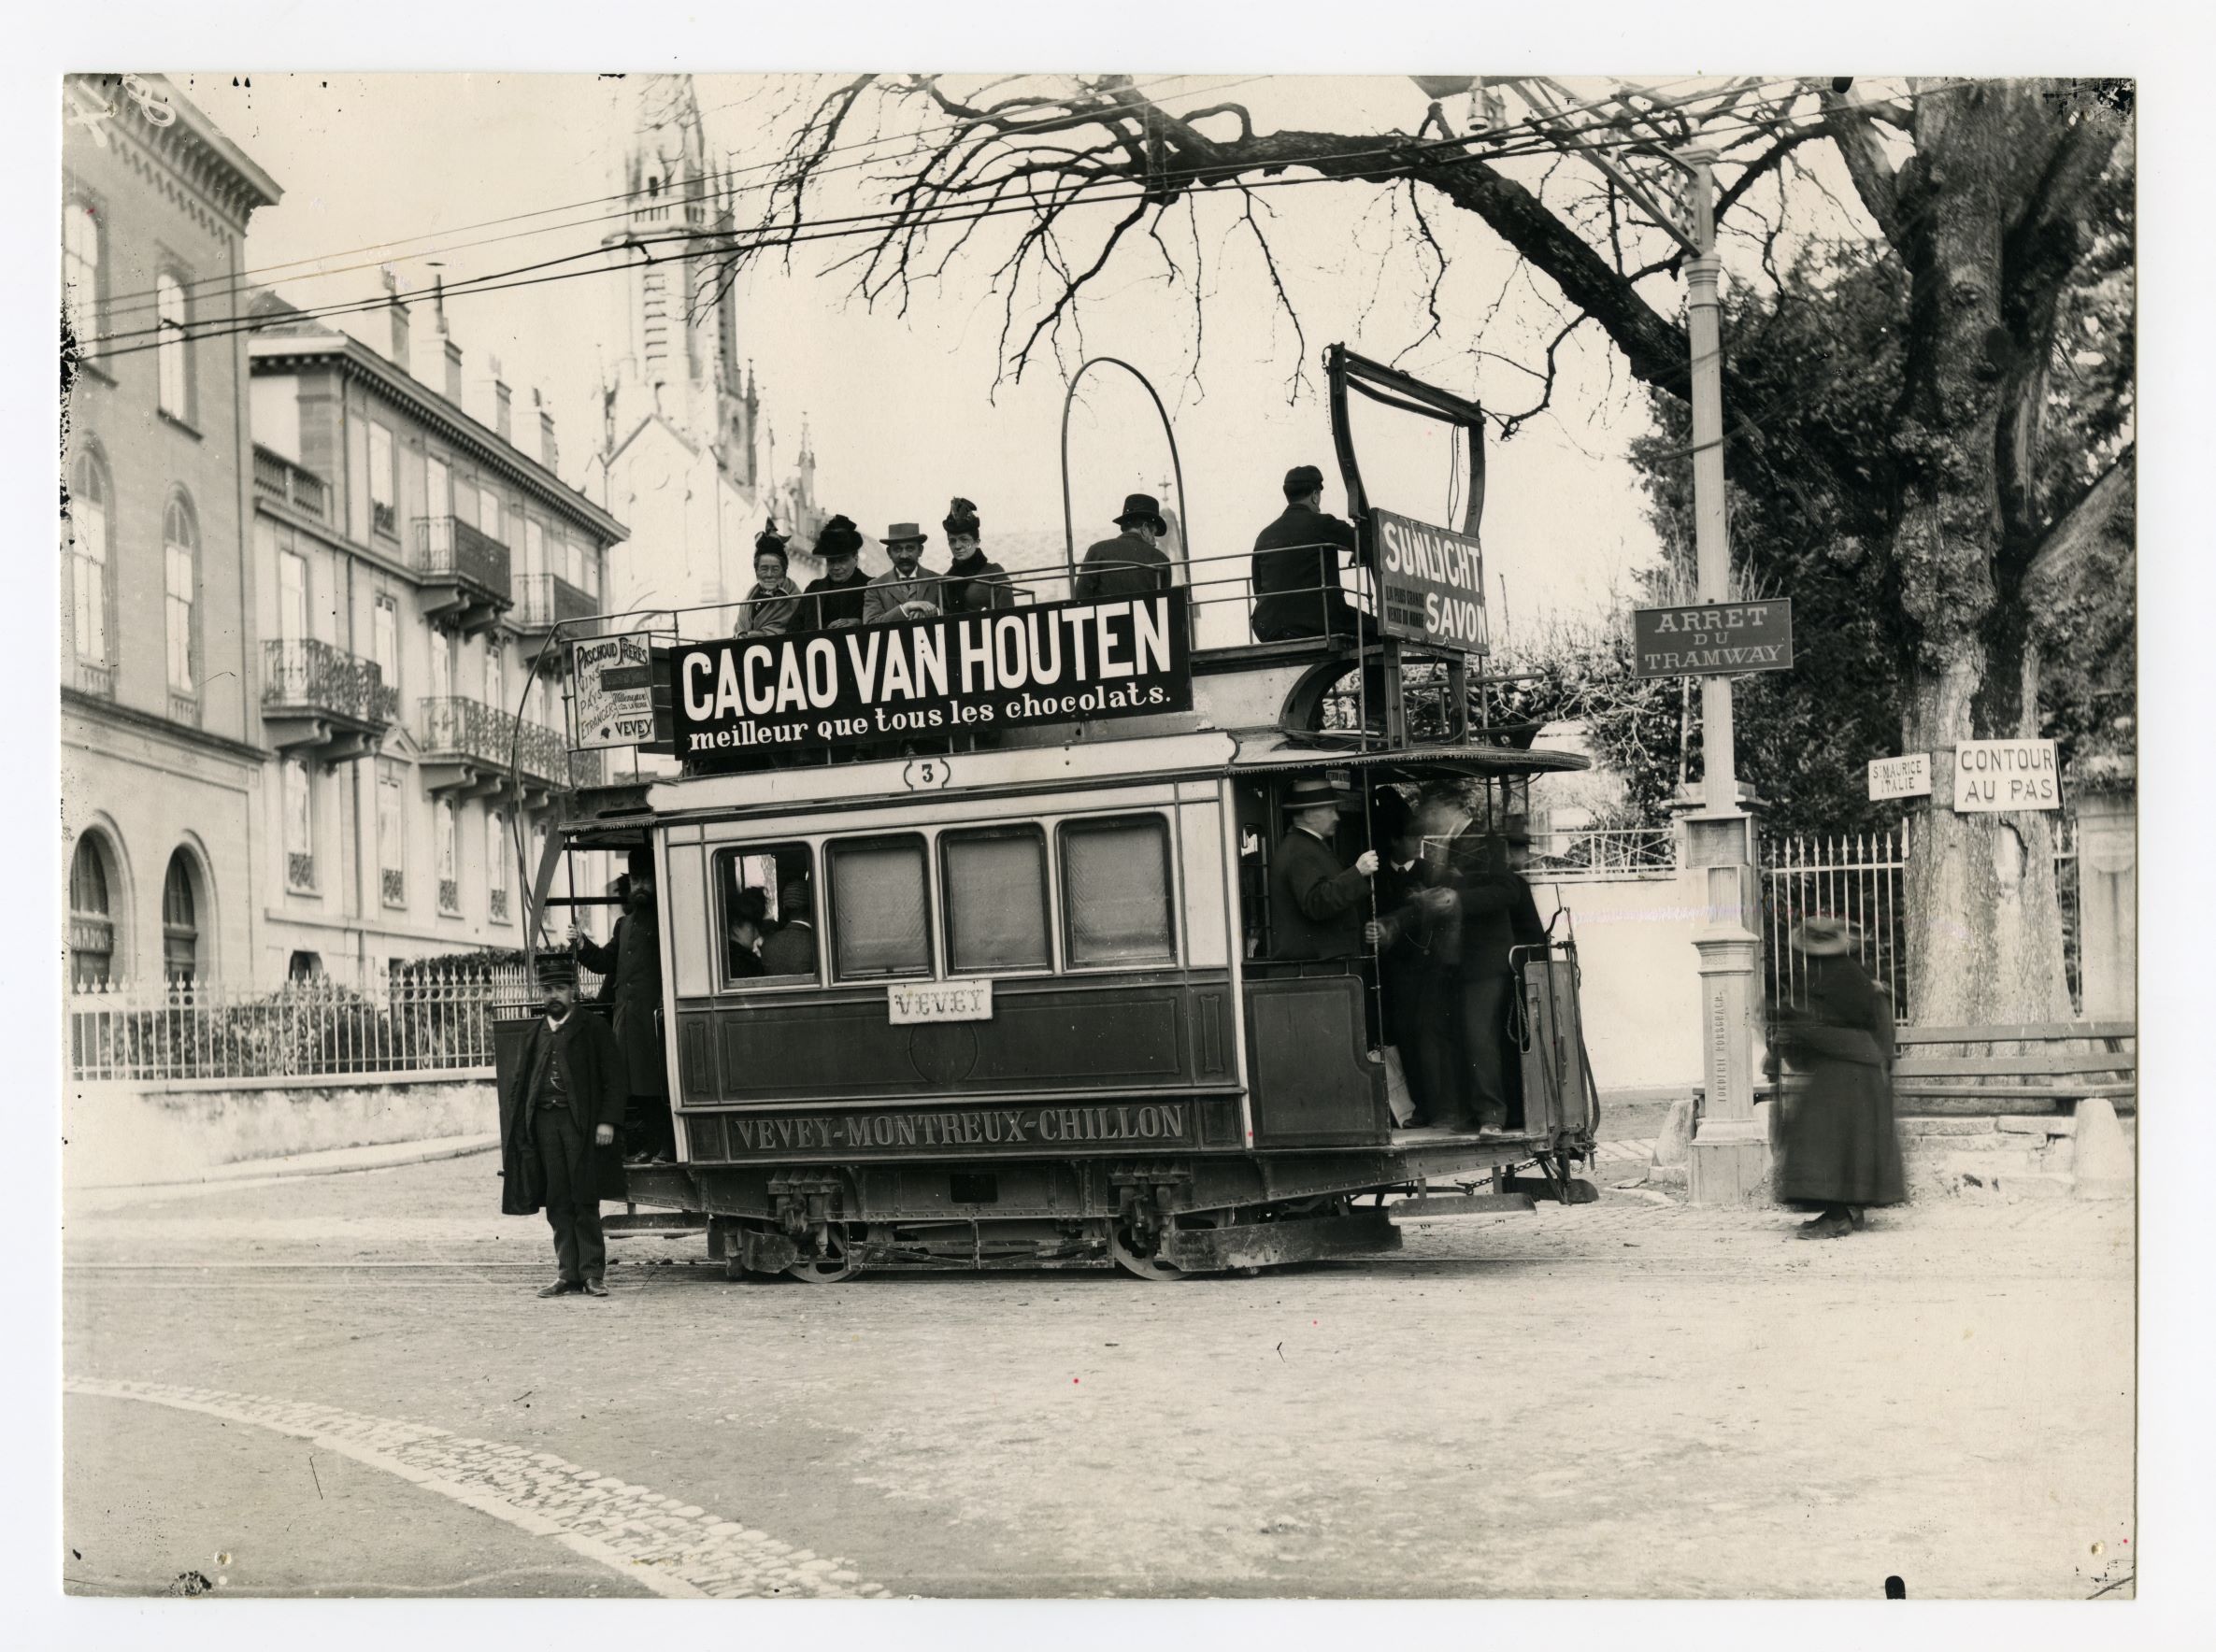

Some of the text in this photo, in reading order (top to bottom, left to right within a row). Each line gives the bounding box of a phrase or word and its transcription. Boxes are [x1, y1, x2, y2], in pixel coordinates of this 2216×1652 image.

[1426, 591, 1488, 645] SAVON
[1654, 607, 1767, 634] ARRET
[1694, 632, 1729, 646] DU
[682, 597, 1171, 721] CACAO VAN HOUTEN
[1645, 645, 1784, 670] TRAMWAY
[580, 689, 603, 715] PAYS
[690, 720, 808, 750] meilleur
[875, 707, 943, 732] tous
[951, 700, 994, 724] les
[1006, 682, 1170, 719] chocolats.
[615, 719, 652, 739] VEVEY
[1961, 748, 2053, 771] CONTOUR
[922, 763, 934, 783] 3
[1881, 776, 1915, 793] ITALIE
[1965, 778, 2053, 803] AU PAS
[894, 990, 984, 1016] VEVEY
